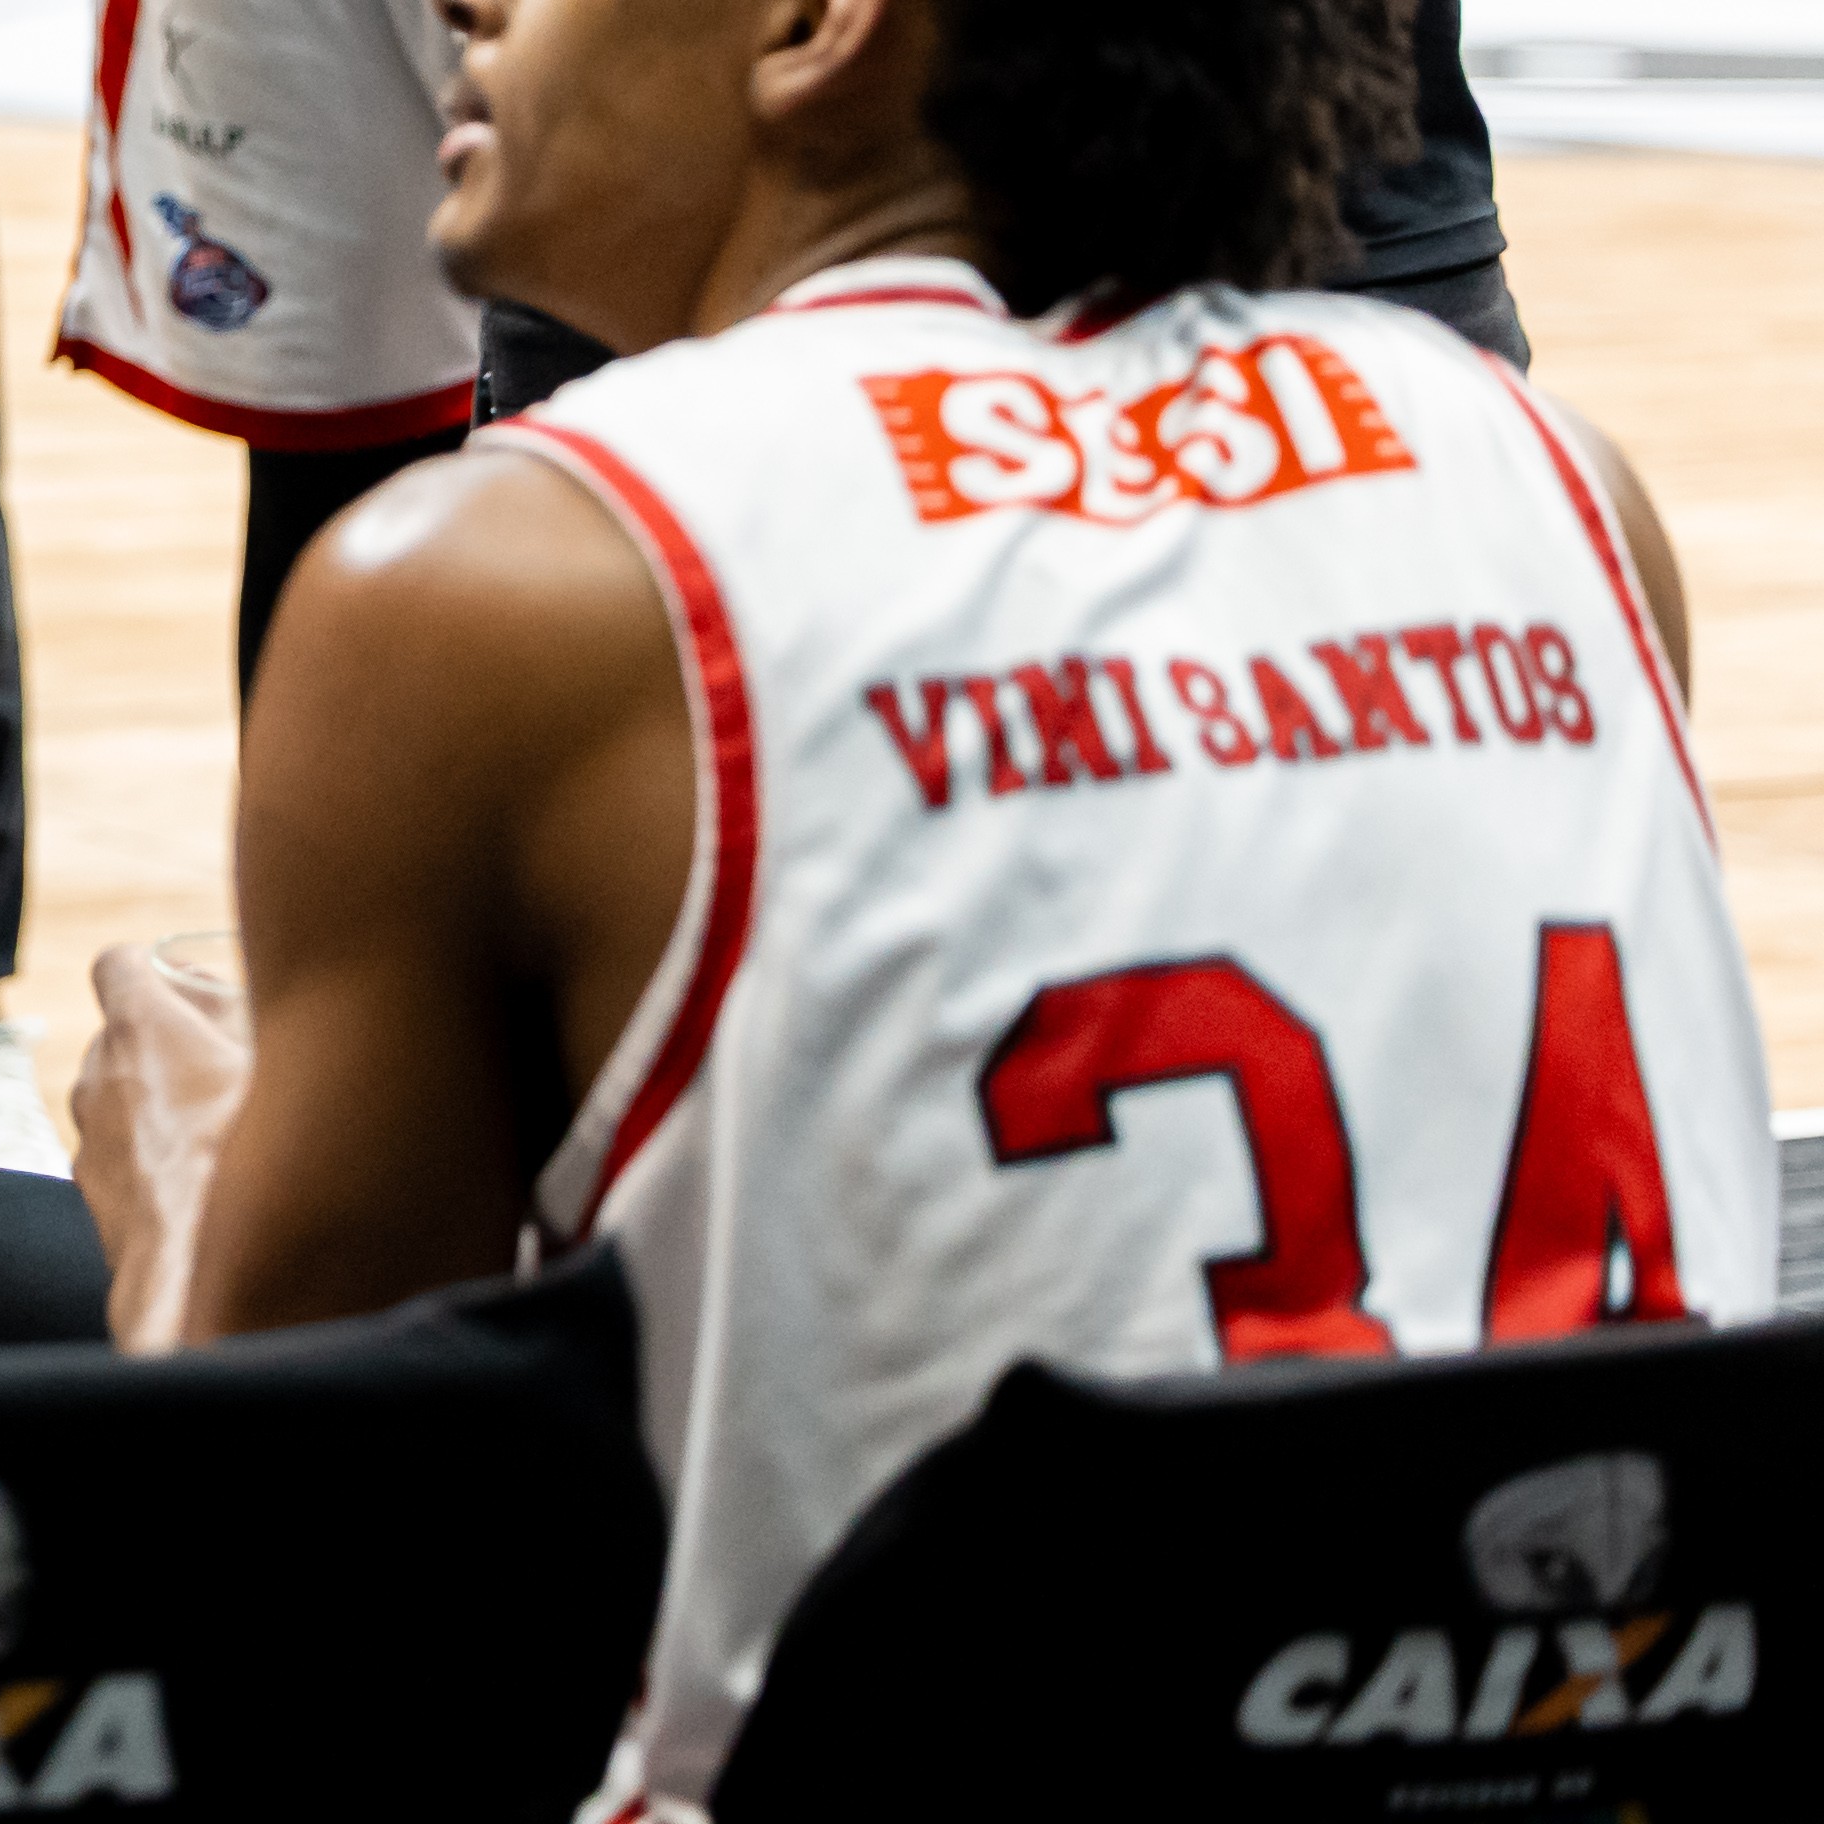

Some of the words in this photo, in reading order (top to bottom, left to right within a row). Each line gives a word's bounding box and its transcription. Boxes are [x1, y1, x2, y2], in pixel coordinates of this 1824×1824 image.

[862, 651, 1172, 813] VINI
[1168, 620, 1597, 768] SANTOS
[1236, 1601, 1758, 1748] CAIXA
